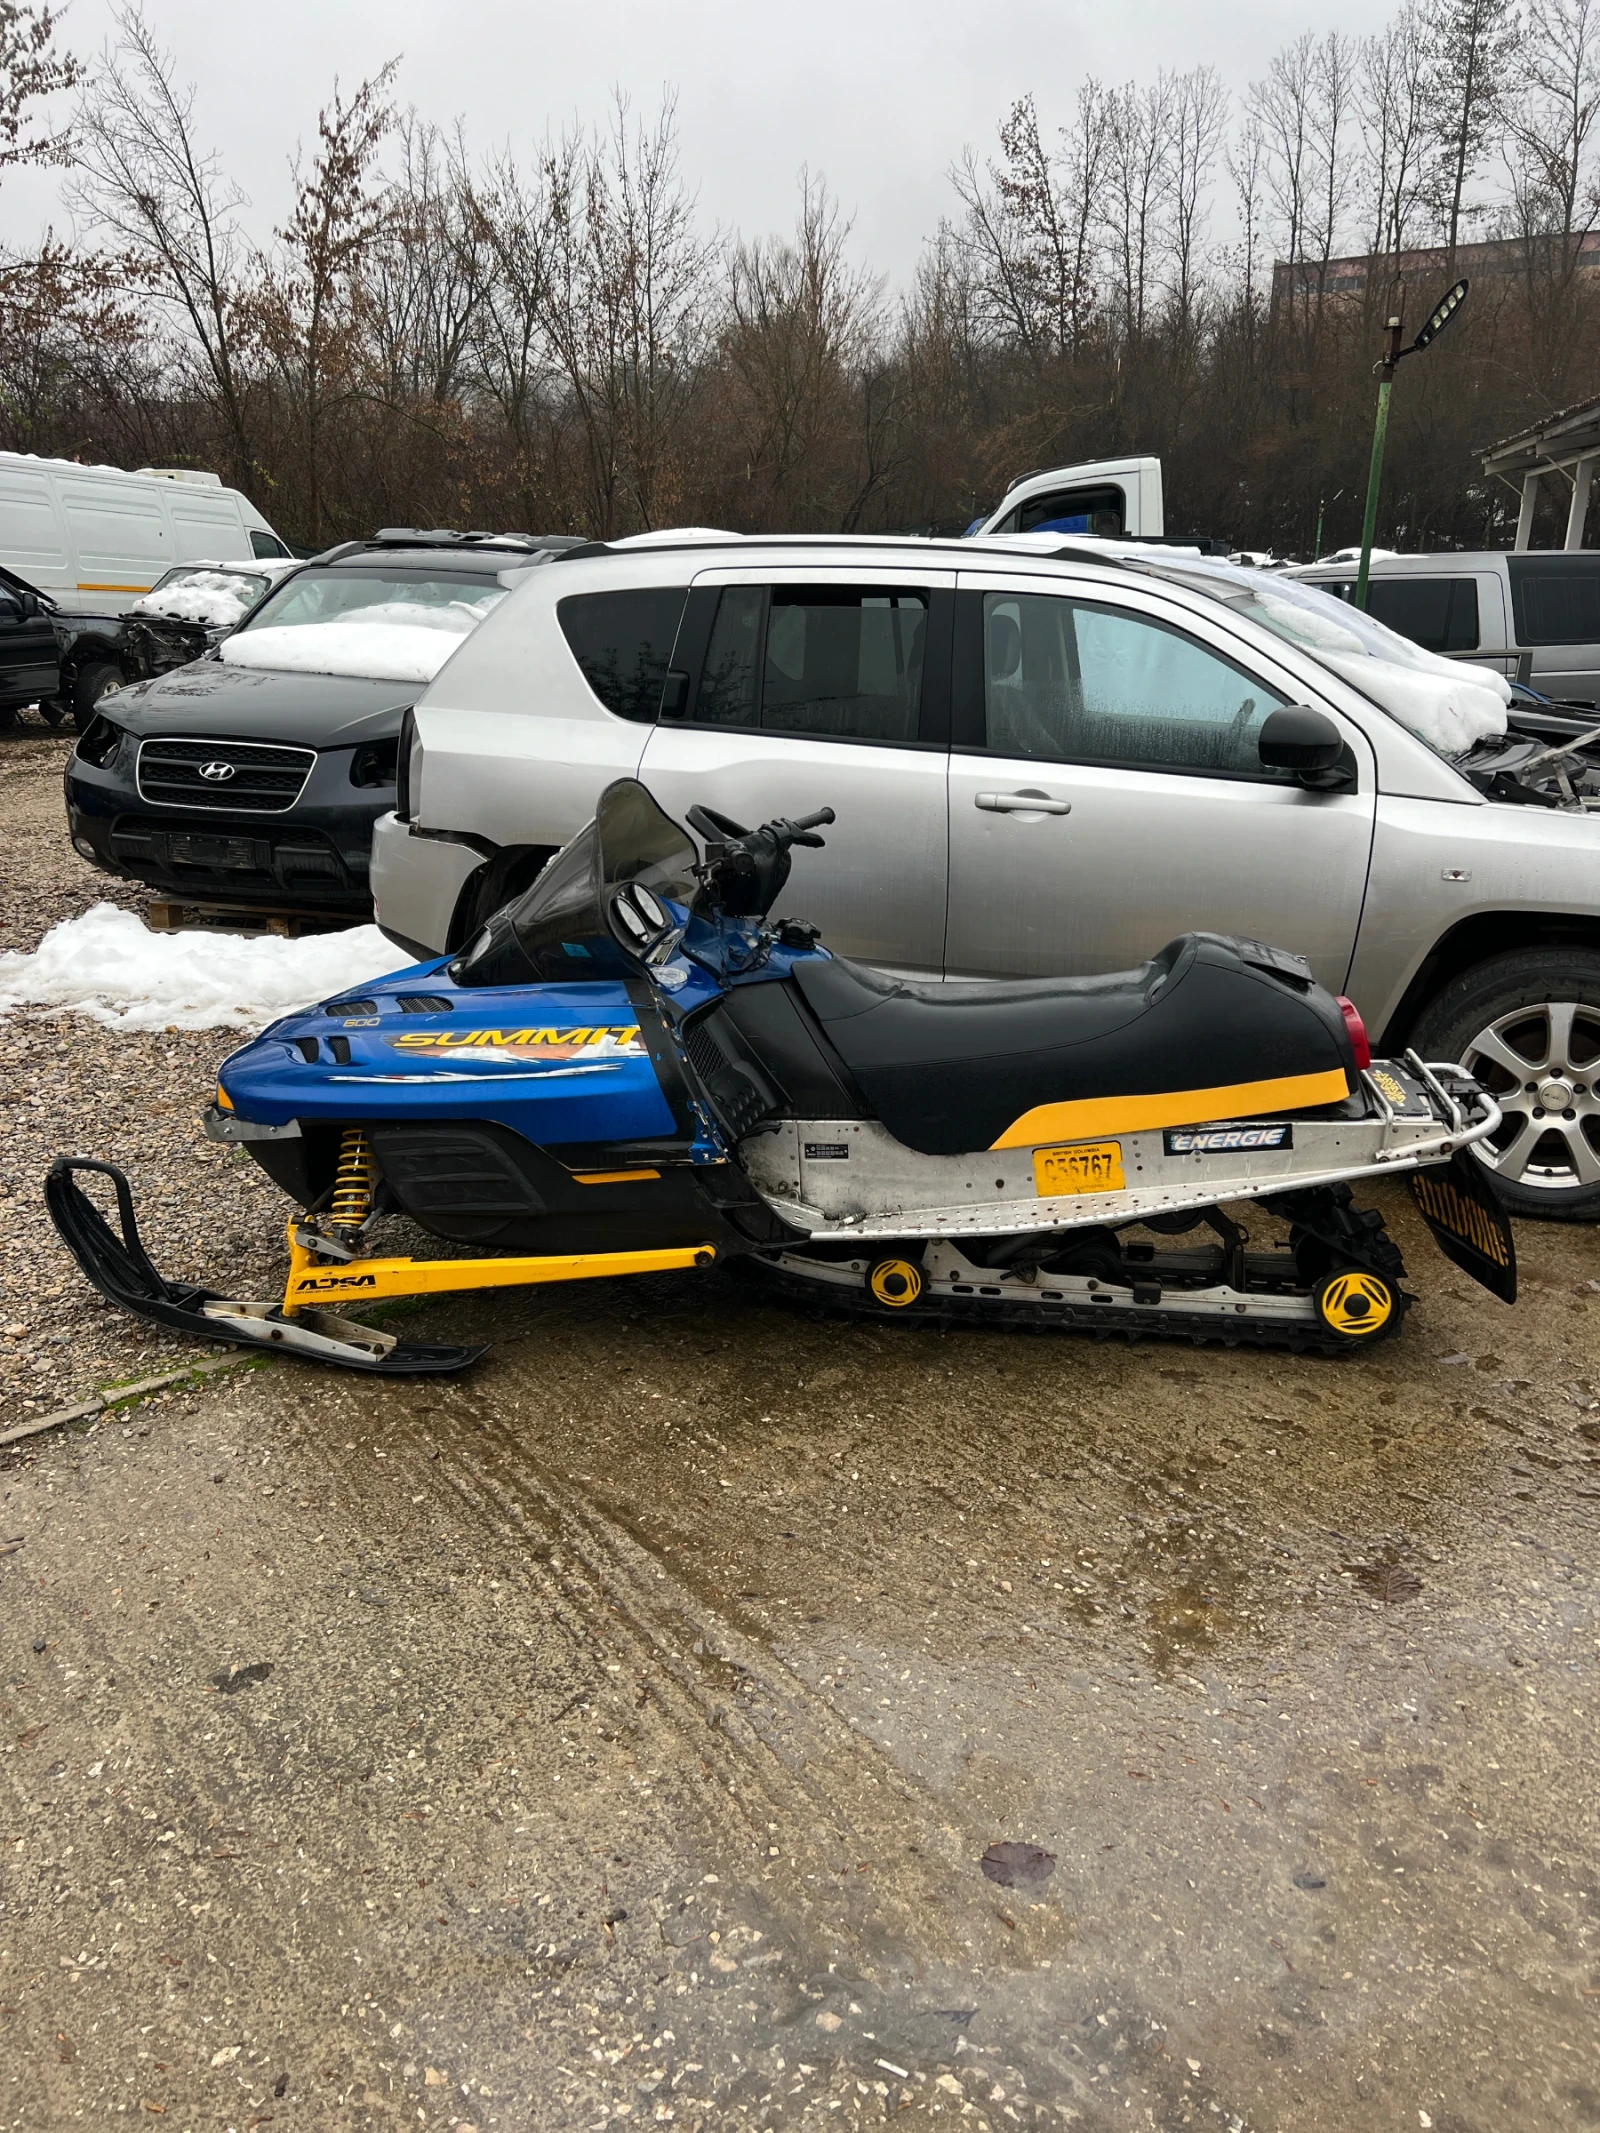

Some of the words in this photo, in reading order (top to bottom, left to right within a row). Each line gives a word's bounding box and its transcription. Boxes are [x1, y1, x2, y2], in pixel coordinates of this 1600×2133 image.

[343, 1017, 380, 1028] 600
[393, 1027, 640, 1047] SUMMIT
[1173, 1128, 1286, 1151] ENERGIE
[296, 1275, 376, 1291] ADSA
